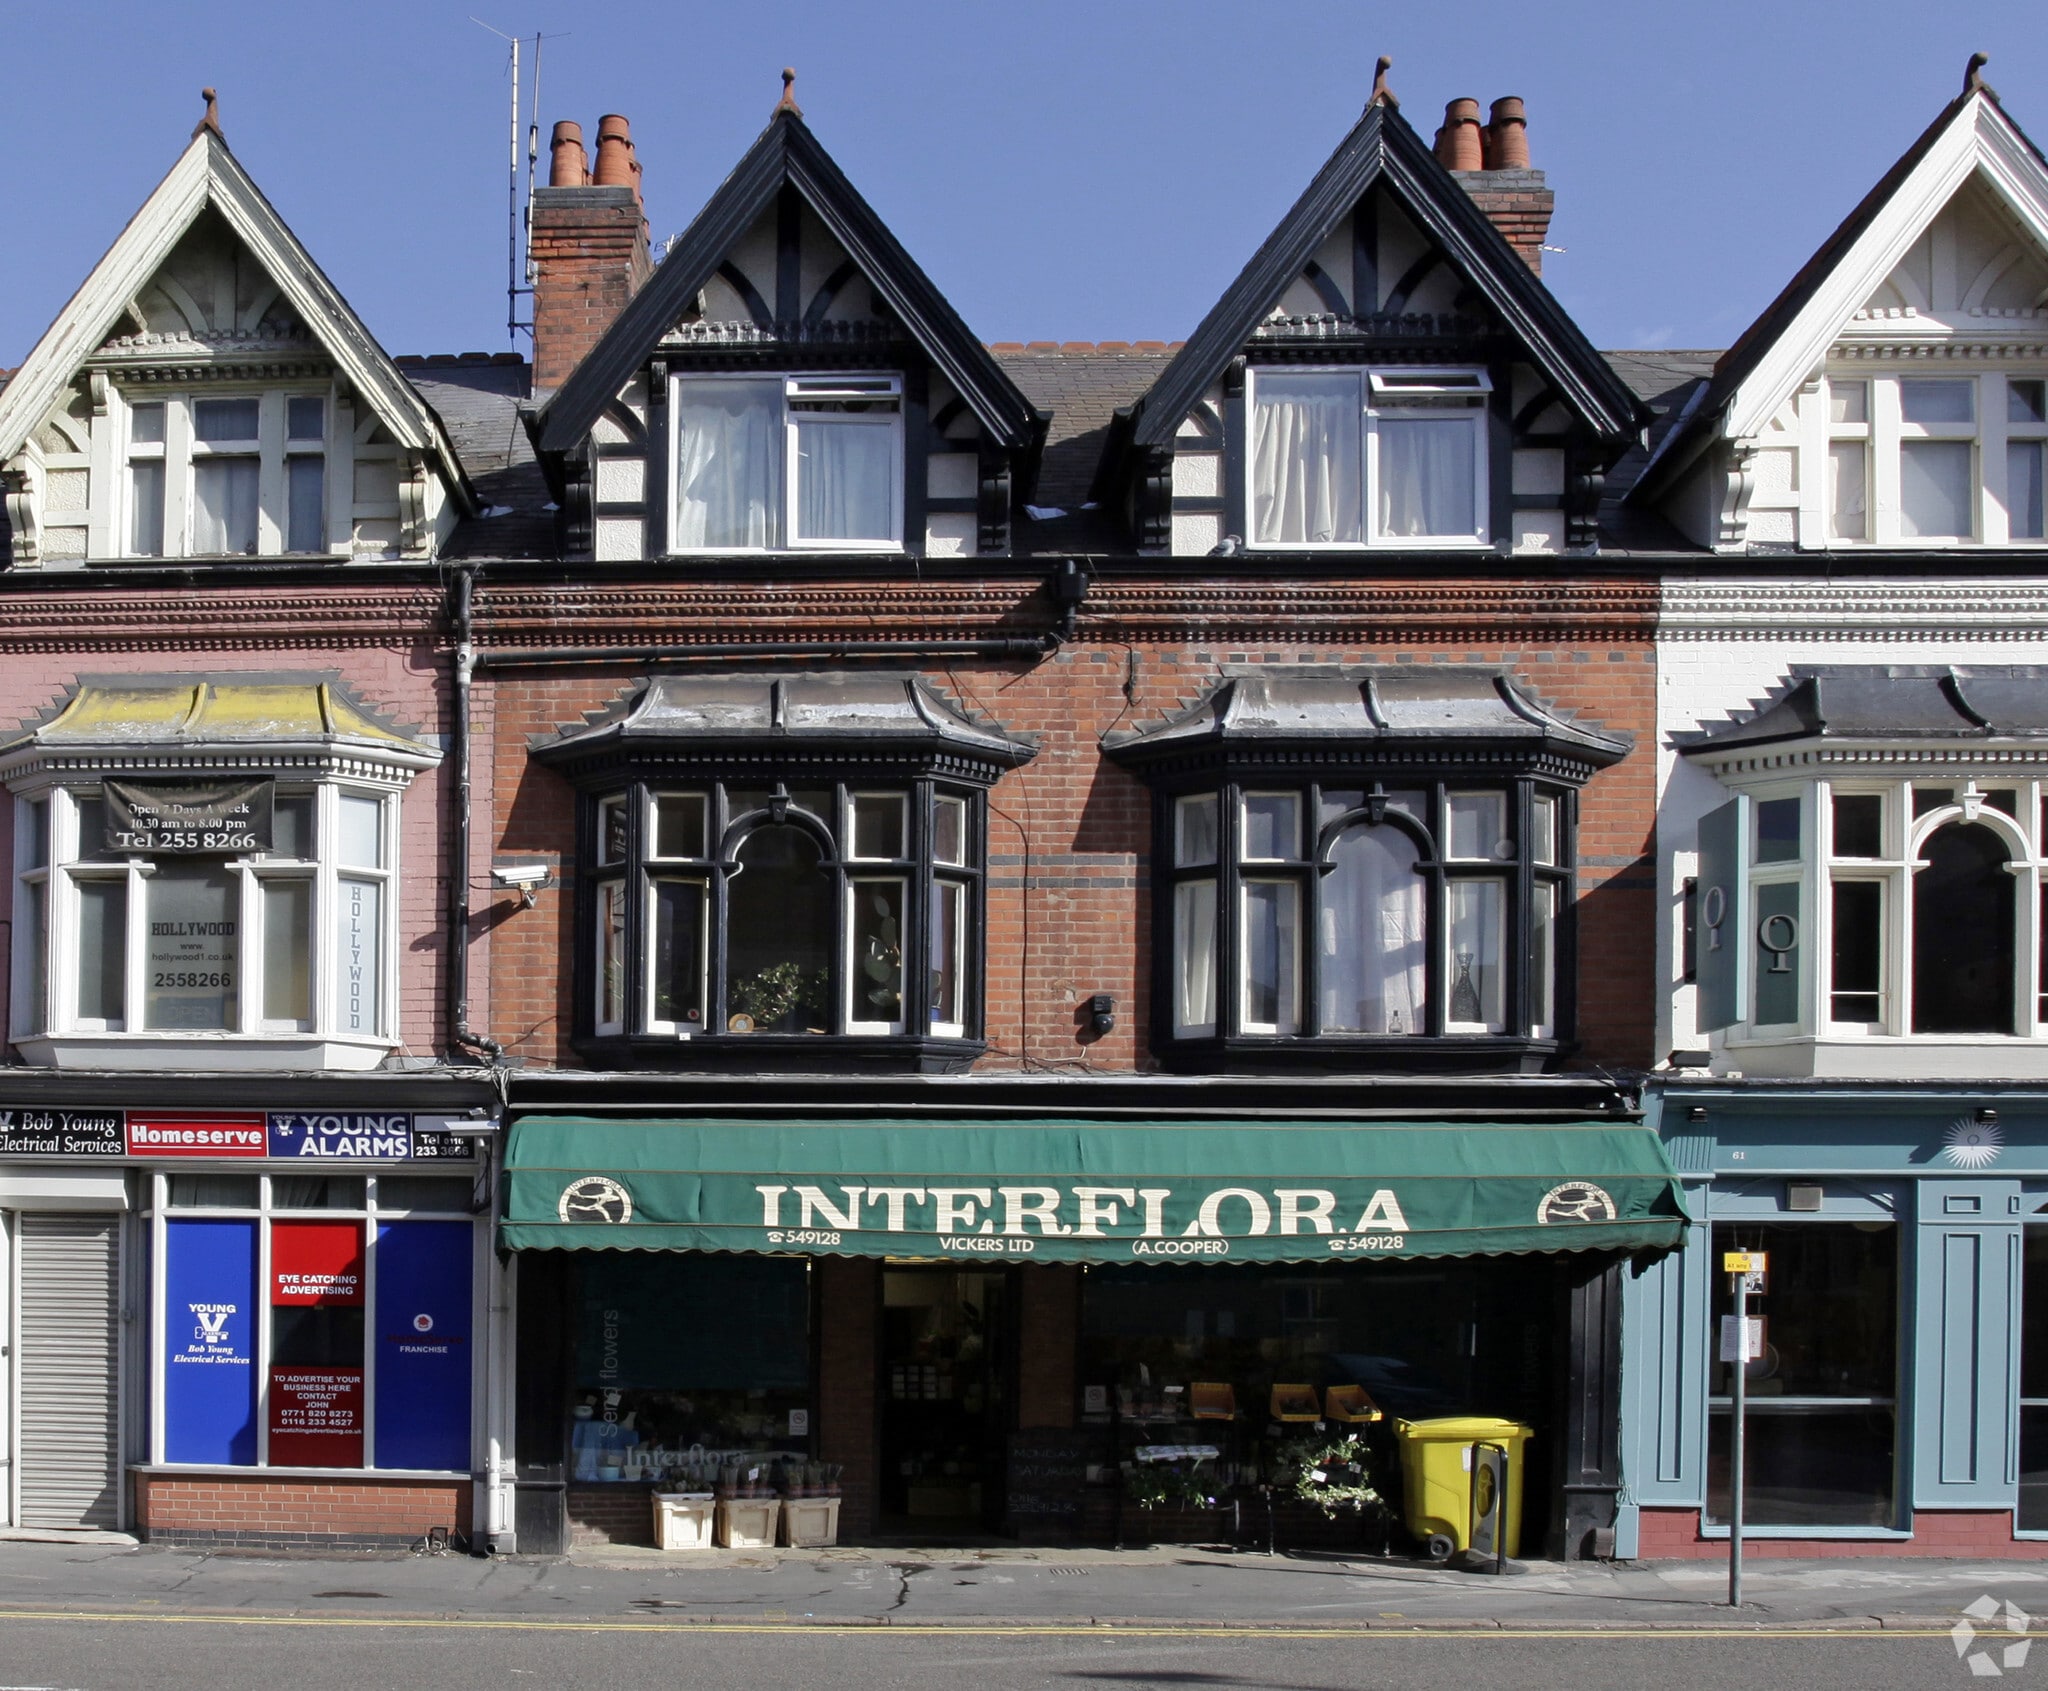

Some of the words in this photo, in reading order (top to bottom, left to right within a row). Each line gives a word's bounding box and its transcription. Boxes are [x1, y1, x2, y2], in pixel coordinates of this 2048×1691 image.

[128, 803, 159, 816] Open
[163, 804, 170, 814] 7
[173, 804, 202, 817] Days
[130, 818, 158, 829] 10.30
[161, 820, 180, 829] am
[184, 820, 195, 829] to
[225, 820, 247, 831] pm
[116, 831, 153, 848] Tel
[160, 833, 198, 848] 255
[203, 833, 256, 849] 8266
[152, 922, 235, 936] HOLLYWOOD
[349, 886, 362, 1029] HOLLYWOOD
[155, 973, 231, 987] 2558266
[22, 1112, 53, 1130] Bob
[59, 1113, 116, 1138] Young
[300, 1116, 407, 1136] YOUNG
[131, 1125, 263, 1144] Homeserve
[421, 1134, 440, 1145] Tel
[64, 1136, 122, 1153] Services
[299, 1137, 408, 1156] ALARMS
[416, 1146, 437, 1156] 233
[1732, 1151, 1745, 1160] 61
[755, 1185, 1410, 1238] INTERFLORA
[786, 1231, 841, 1245] 549128
[939, 1237, 1004, 1251] VICKERS
[1008, 1239, 1035, 1252] LTD
[1348, 1235, 1404, 1250] 549128
[1132, 1239, 1229, 1255] (A.COOPER)
[278, 1274, 300, 1283] EYE
[302, 1275, 357, 1284] CATCHING
[282, 1285, 354, 1295] ADVERTISING
[189, 1304, 236, 1313] YOUNG
[188, 1344, 205, 1353] Bob
[208, 1345, 233, 1355] Young
[599, 1309, 618, 1379] flowers
[174, 1354, 214, 1363] Electrical
[215, 1355, 250, 1364] Services
[287, 1375, 334, 1383] ADVERTISE
[328, 1384, 351, 1392] HERE
[297, 1392, 337, 1400] CONTACT
